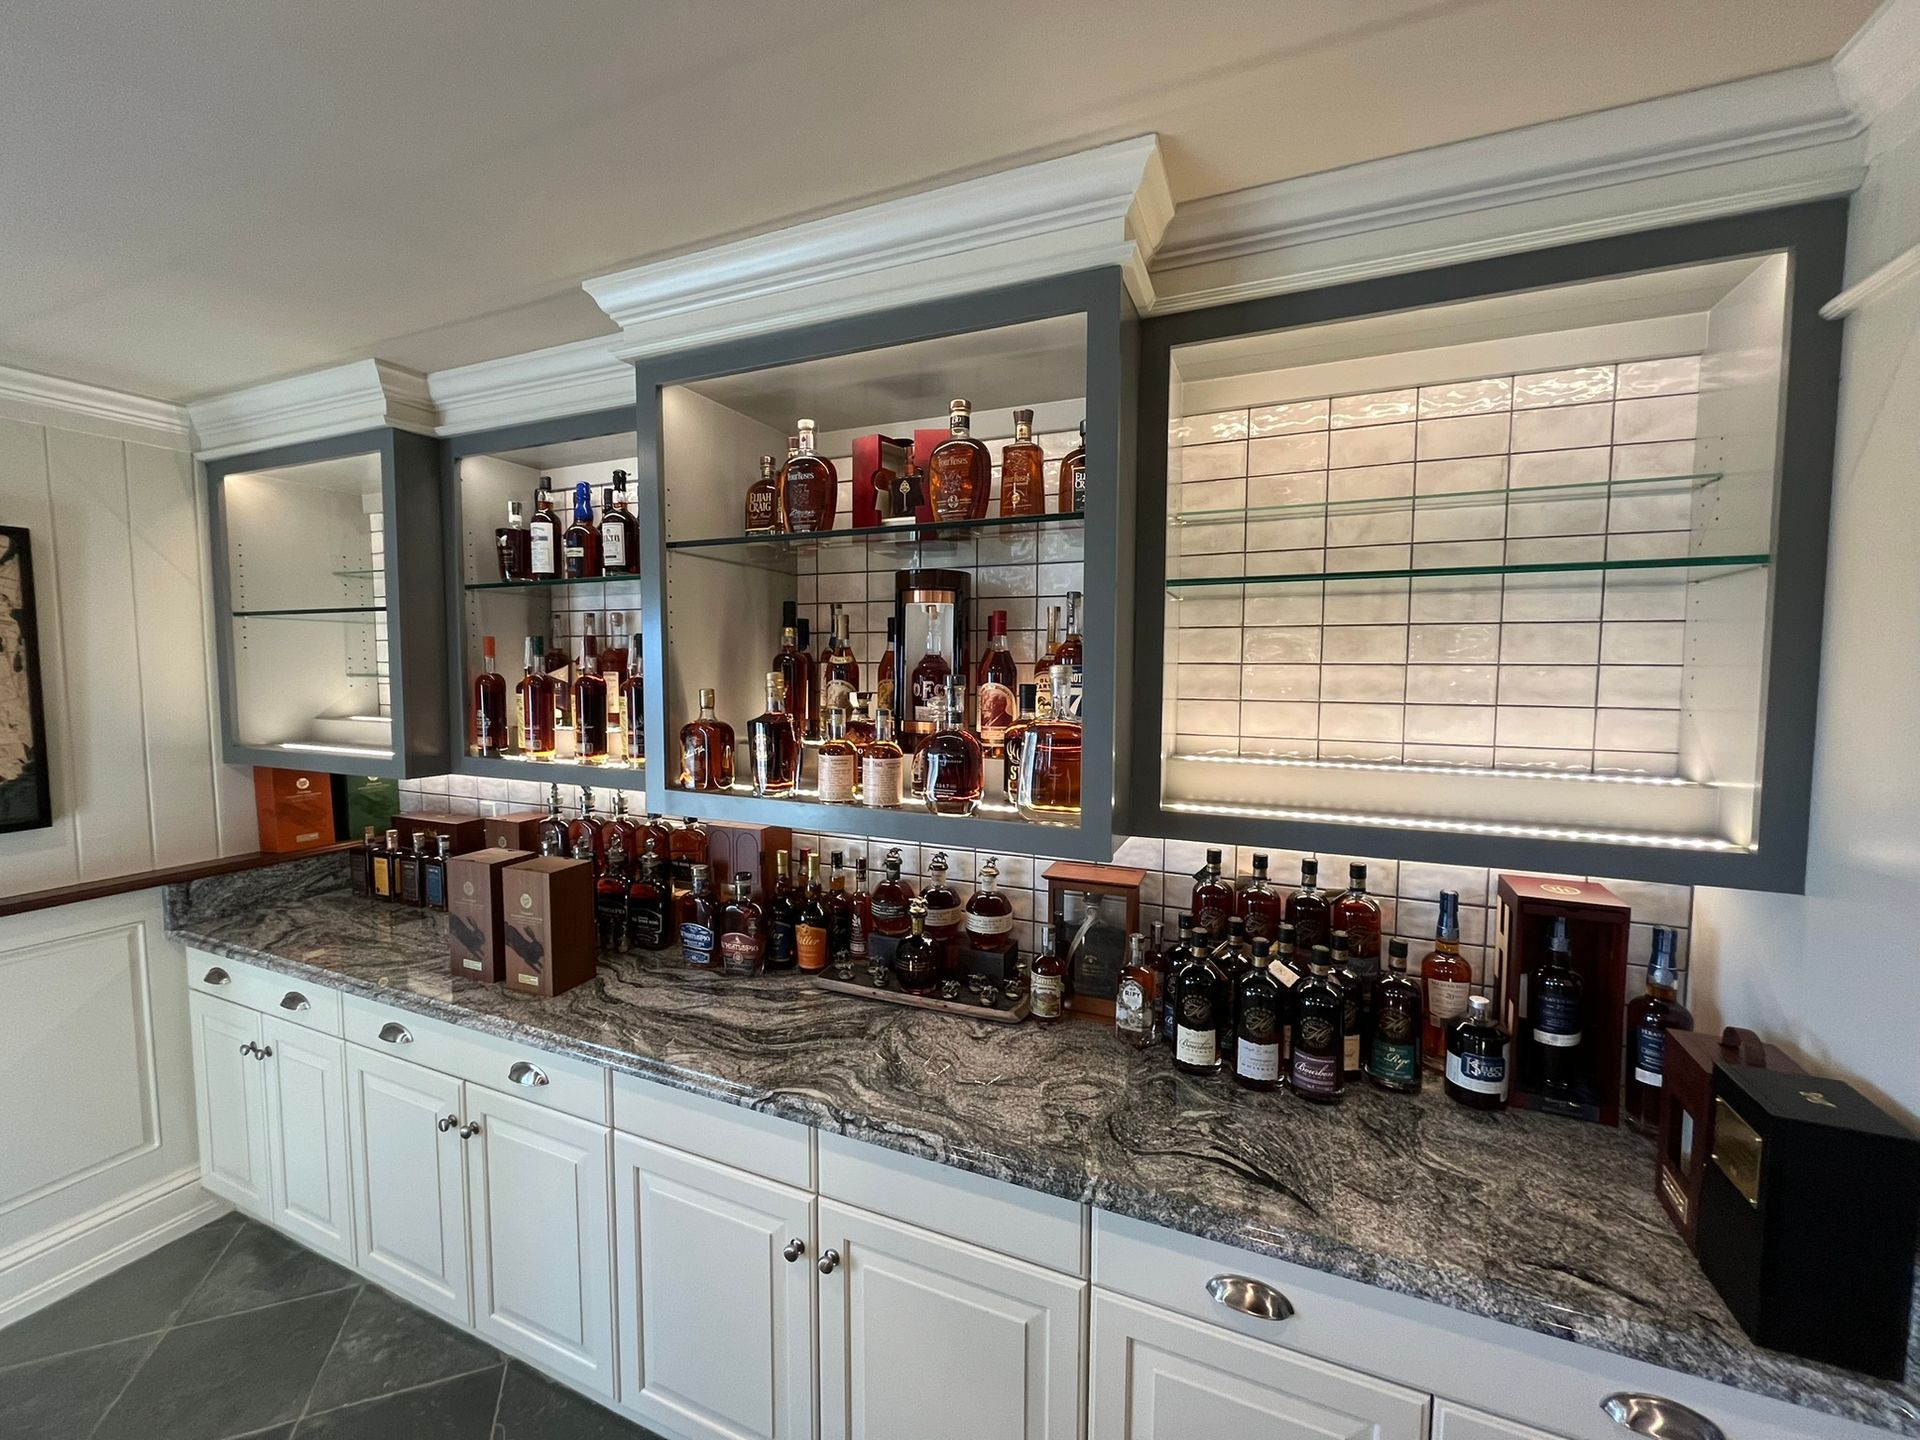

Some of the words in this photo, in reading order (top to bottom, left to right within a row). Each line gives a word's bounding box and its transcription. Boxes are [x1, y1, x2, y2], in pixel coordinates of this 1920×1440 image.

[749, 492, 772, 503] ELIJAH
[749, 502, 772, 512] CRAIG
[1383, 1052, 1411, 1071] Rye
[1294, 1061, 1335, 1078] Bourbon
